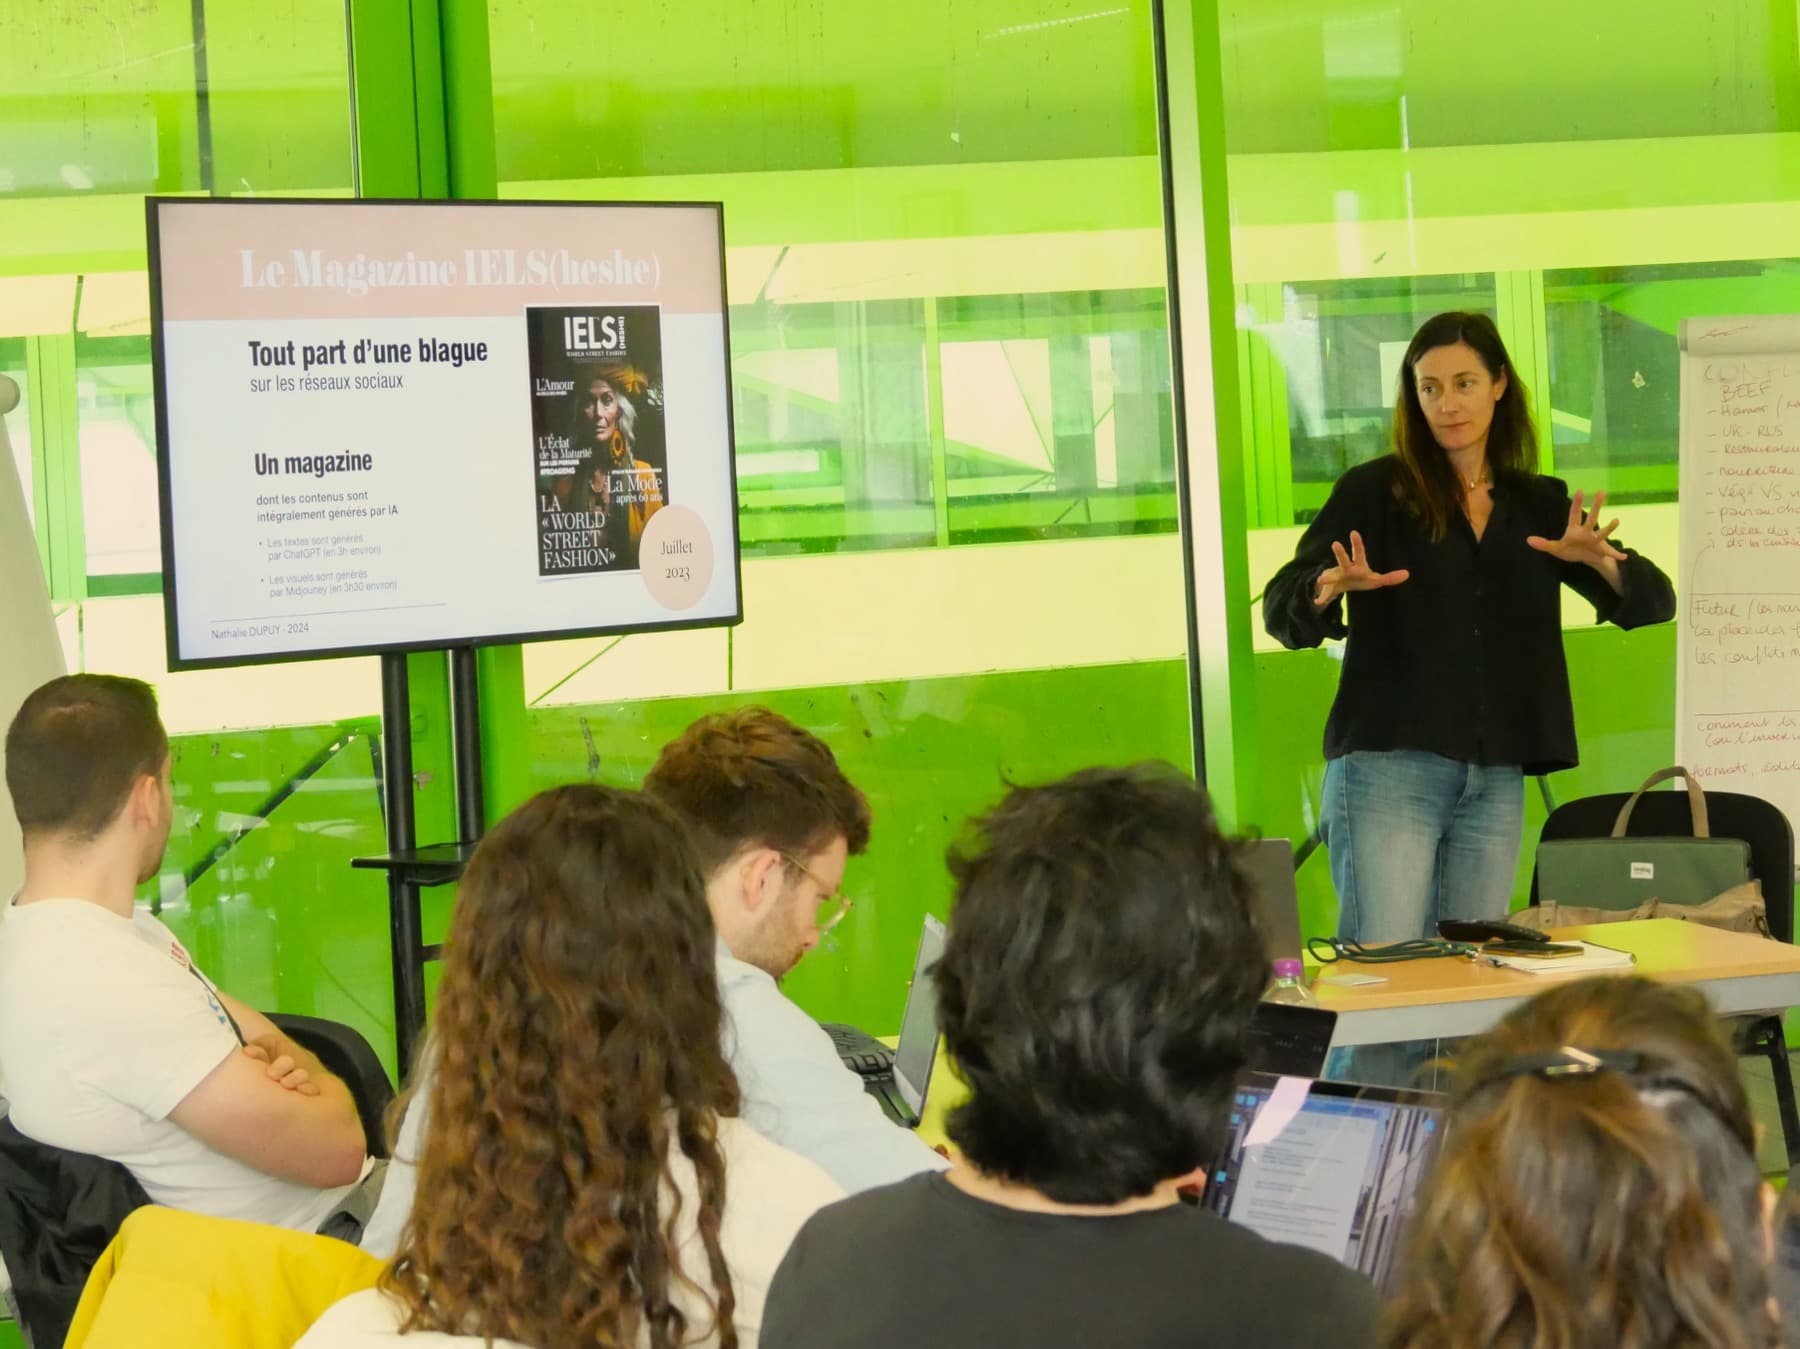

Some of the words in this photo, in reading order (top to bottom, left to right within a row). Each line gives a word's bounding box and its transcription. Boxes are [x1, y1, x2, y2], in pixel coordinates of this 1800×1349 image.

[239, 249, 285, 288] Le
[292, 249, 457, 297] Magazine
[463, 248, 661, 296] IELS(heshe)
[564, 315, 617, 350] IELS
[248, 340, 295, 366] Tout
[302, 340, 346, 371] part
[353, 338, 412, 364] d’une
[418, 337, 488, 368] blague
[250, 377, 272, 392] sur
[276, 375, 295, 391] les
[300, 372, 351, 390] réseaux
[354, 371, 403, 389] sociaux
[1720, 380, 1772, 402] BEEF
[539, 449, 550, 460] de
[551, 449, 559, 459] la
[560, 447, 592, 459] Maturité
[255, 453, 279, 475] Un
[285, 450, 373, 478] magazine
[607, 473, 623, 493] La
[628, 472, 663, 492] Mode
[256, 494, 279, 505] dont
[282, 493, 296, 504] les
[299, 491, 344, 503] contenus
[347, 491, 368, 501] sont
[541, 496, 561, 512] LA
[616, 494, 637, 507] après
[257, 508, 325, 524] intégralement
[328, 506, 367, 520] générés
[370, 505, 385, 518] par
[388, 504, 399, 515] IA
[267, 538, 281, 548] Les
[284, 537, 309, 547] textes
[311, 535, 329, 545] sont
[331, 533, 363, 546] générés
[543, 530, 601, 550] STREET
[660, 539, 693, 555] Juillet
[268, 551, 281, 562] par
[284, 547, 320, 560] ChatGPT
[338, 545, 347, 556] 3h
[544, 547, 616, 569] FASHION»
[269, 575, 284, 585] Les
[287, 573, 314, 584] visuels
[316, 571, 334, 581] sont
[336, 569, 368, 582] générés
[665, 567, 690, 582] 2023
[270, 587, 284, 598] par
[211, 628, 248, 640] Nathalie
[249, 623, 280, 637] DUPUY
[287, 622, 309, 634] 2024
